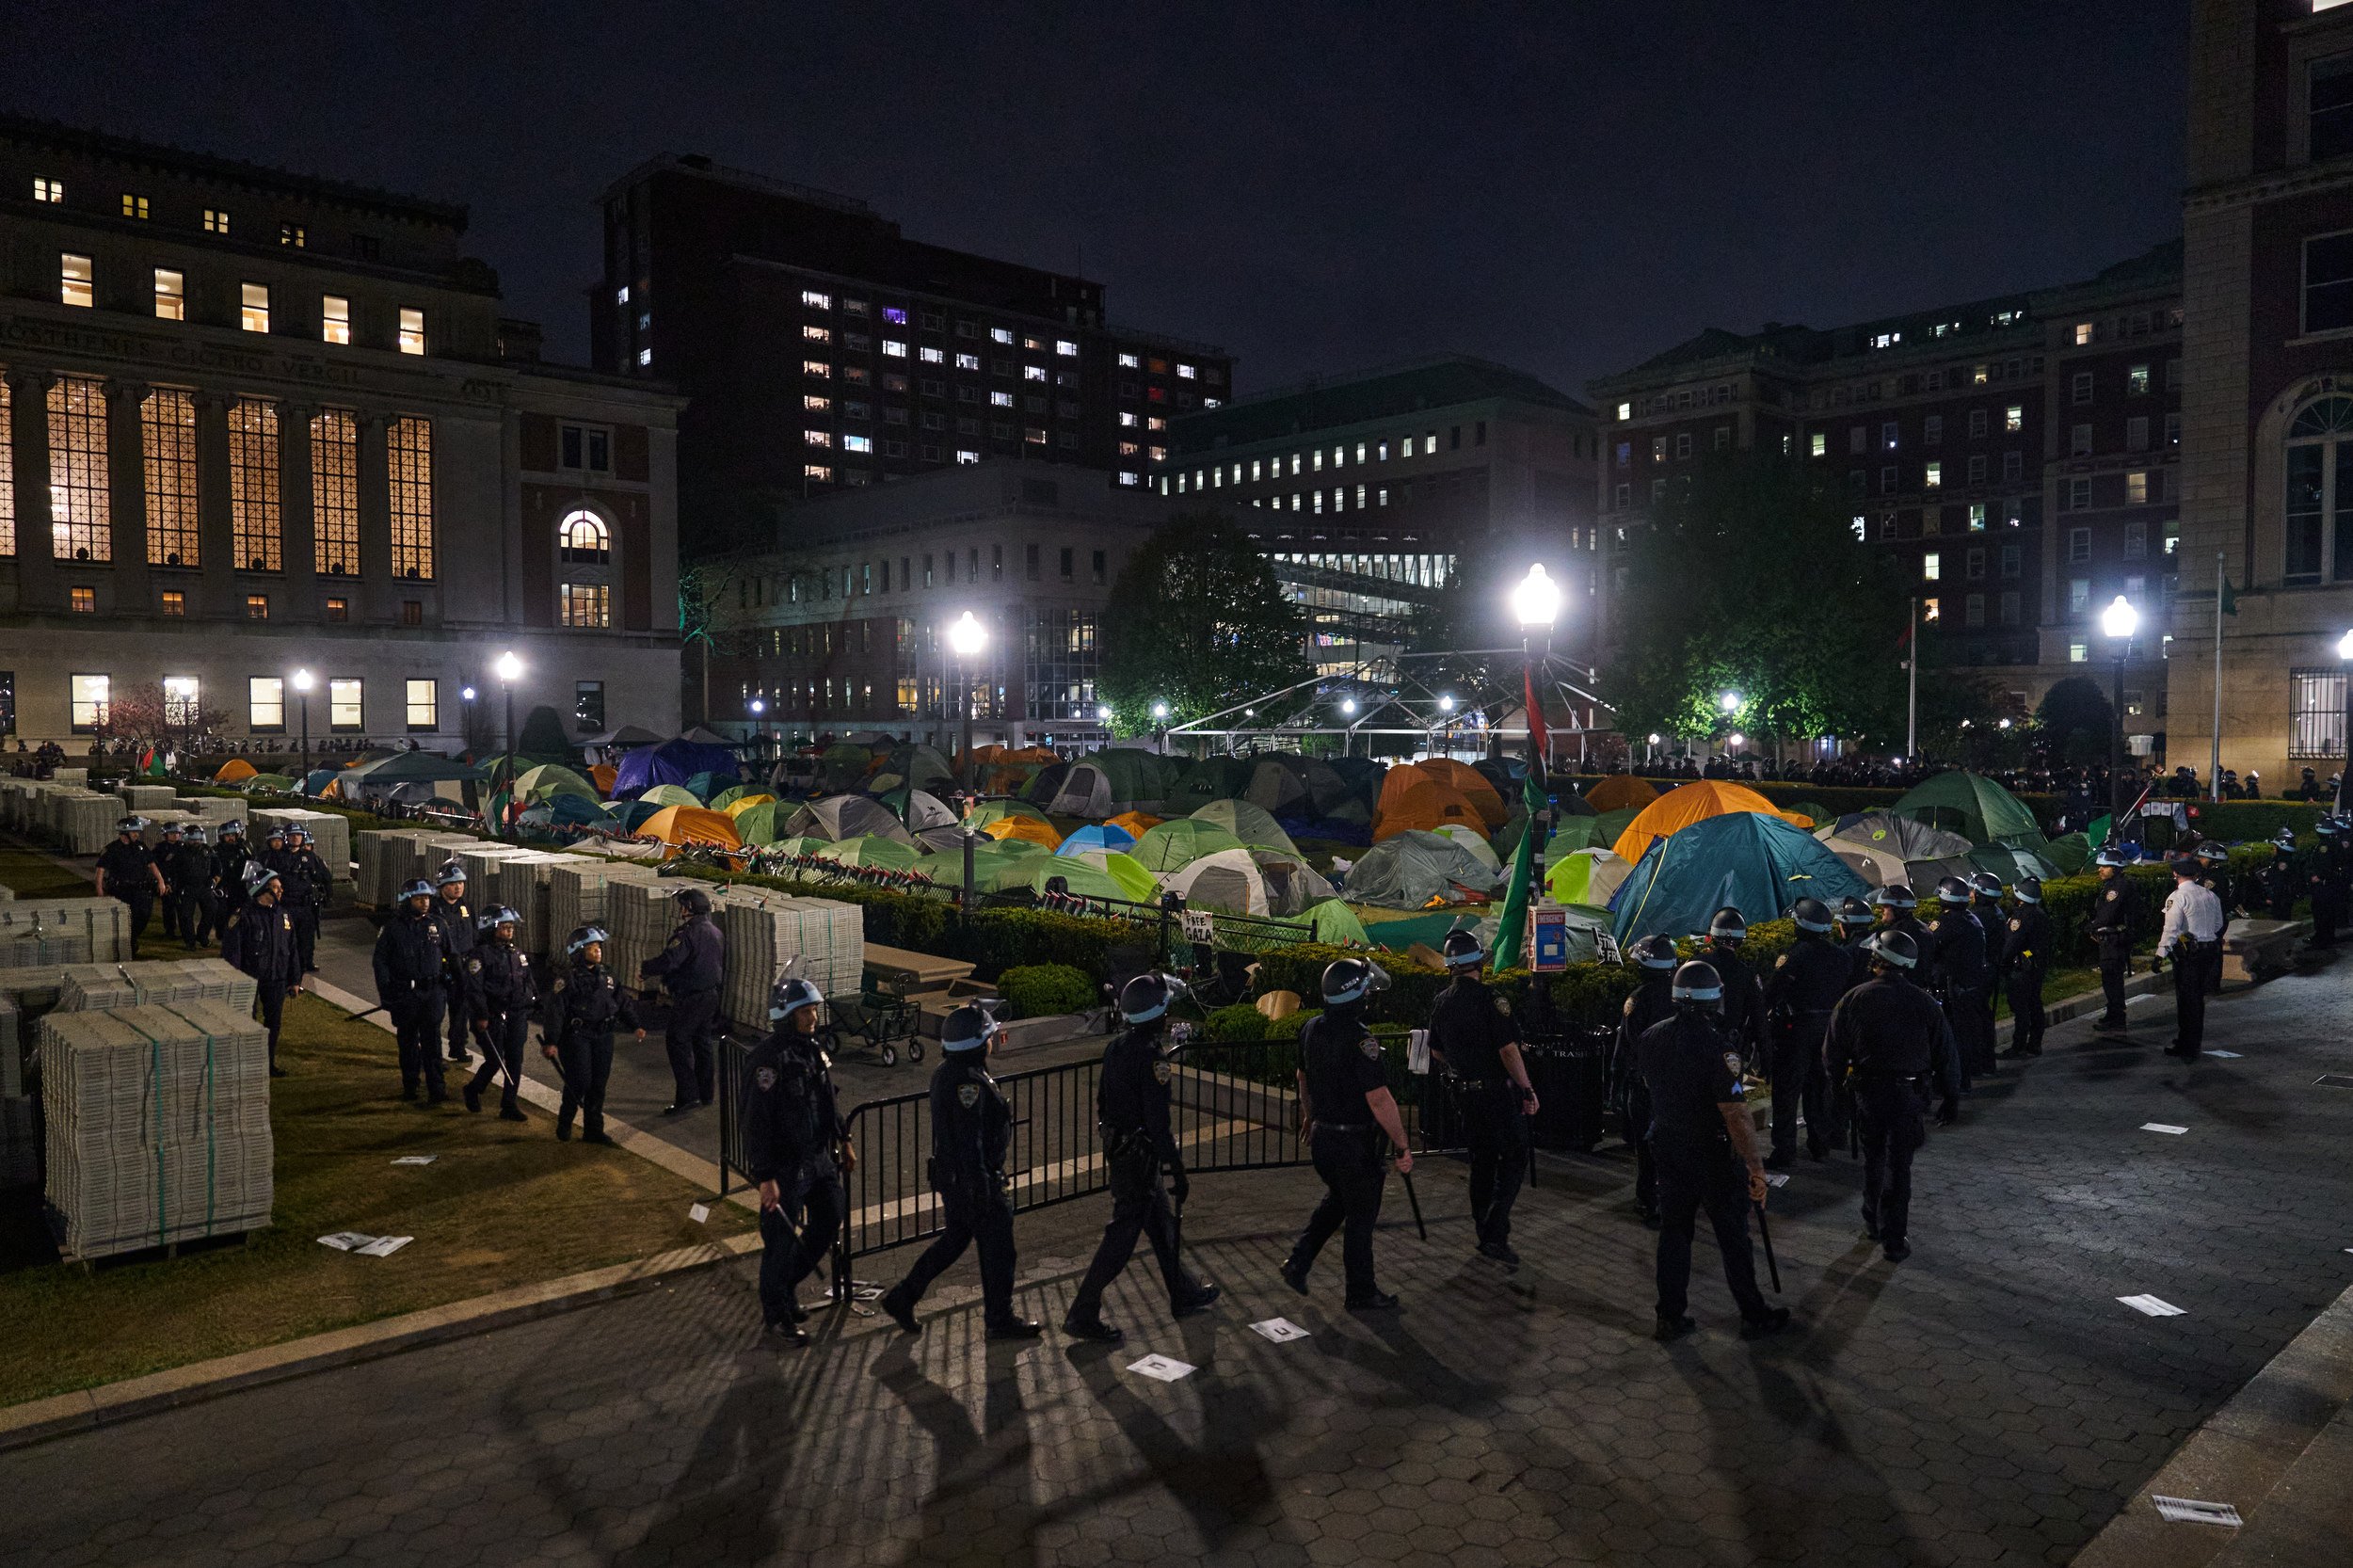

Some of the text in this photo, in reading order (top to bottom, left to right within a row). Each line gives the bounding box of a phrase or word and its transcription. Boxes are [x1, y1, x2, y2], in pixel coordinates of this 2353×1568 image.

[0, 322, 360, 384] OSTHENES CICERO VERGIL
[1186, 915, 1207, 927] FREE
[1185, 927, 1213, 943] GAZA
